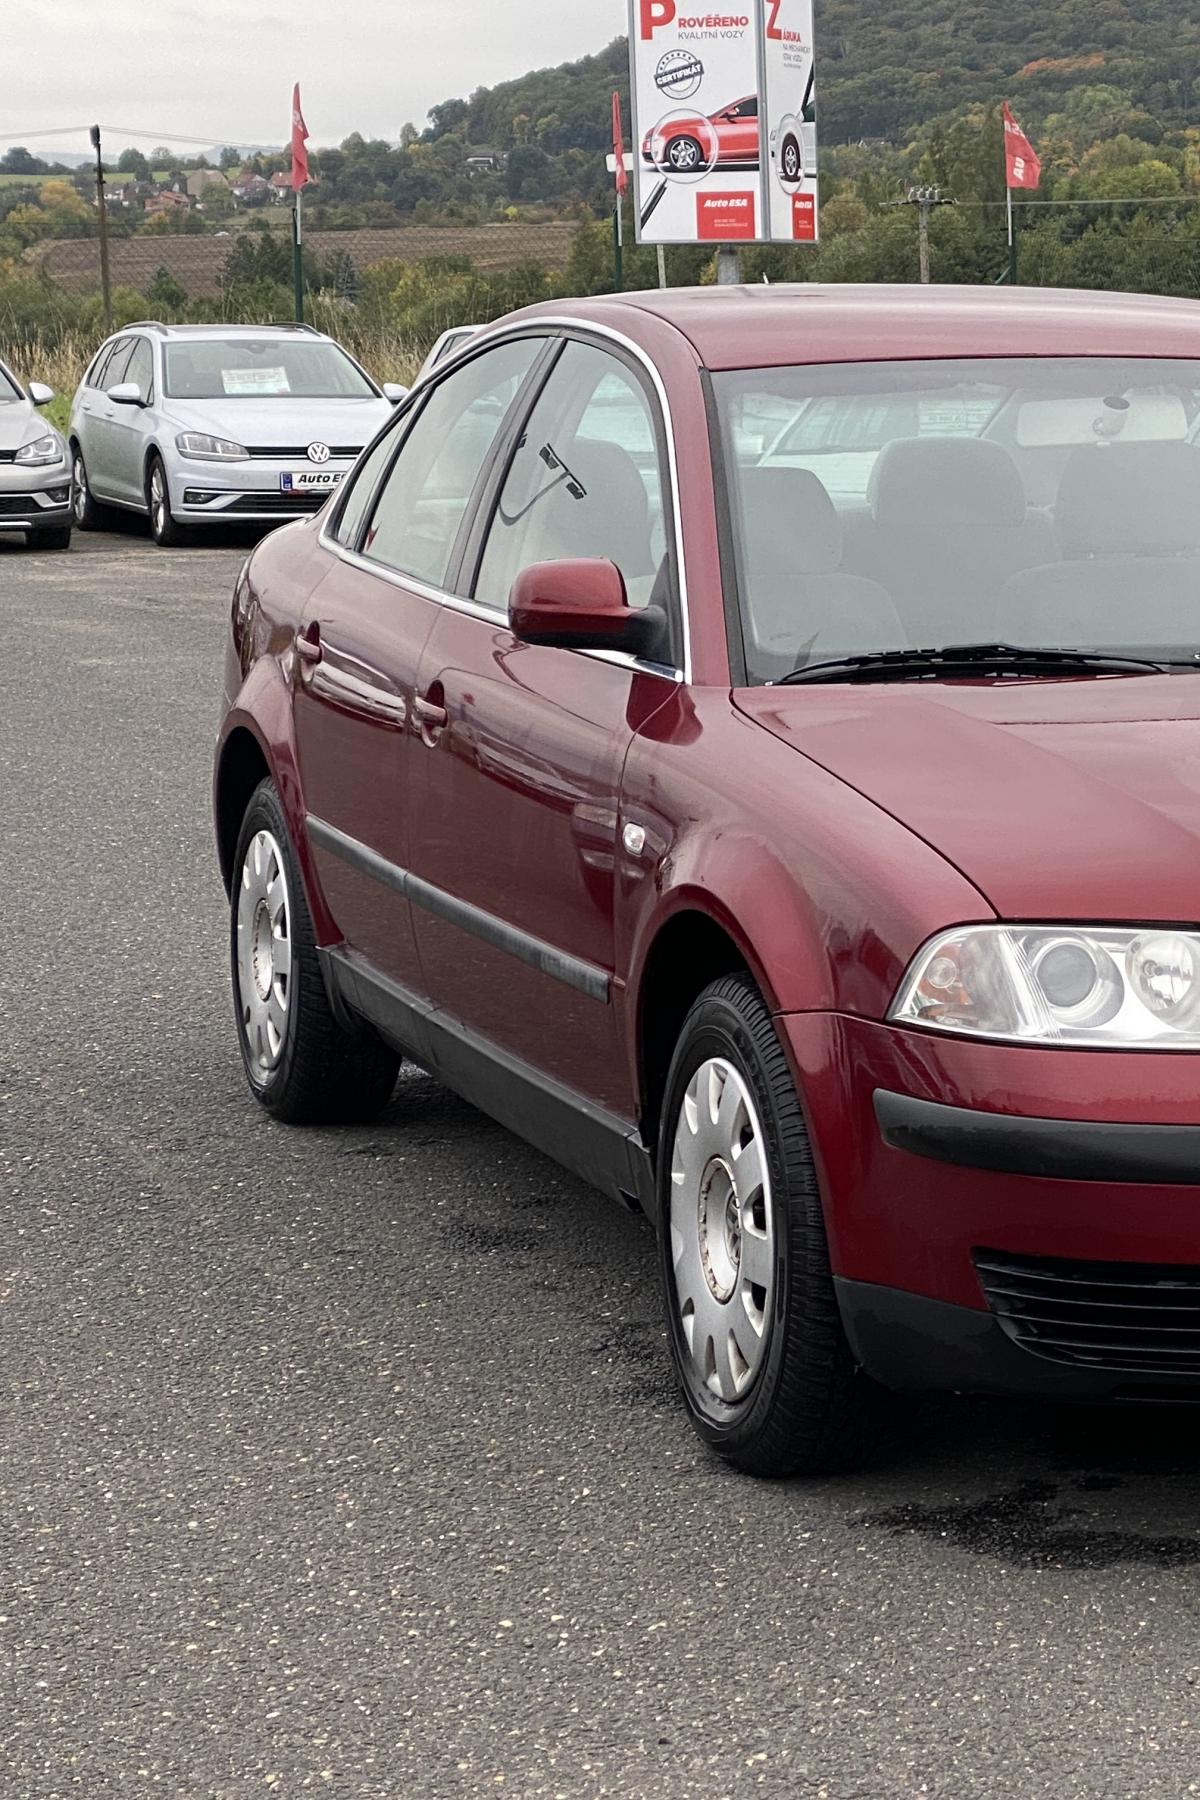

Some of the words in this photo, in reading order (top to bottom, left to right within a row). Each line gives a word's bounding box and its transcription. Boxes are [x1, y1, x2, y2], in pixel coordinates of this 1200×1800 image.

[678, 29, 718, 39] KVALITNÍ
[720, 30, 744, 39] VOZY
[656, 64, 702, 85] CERTIFIKÁT
[703, 199, 728, 208] Auto
[728, 198, 748, 207] ESA
[298, 473, 331, 484] Auto
